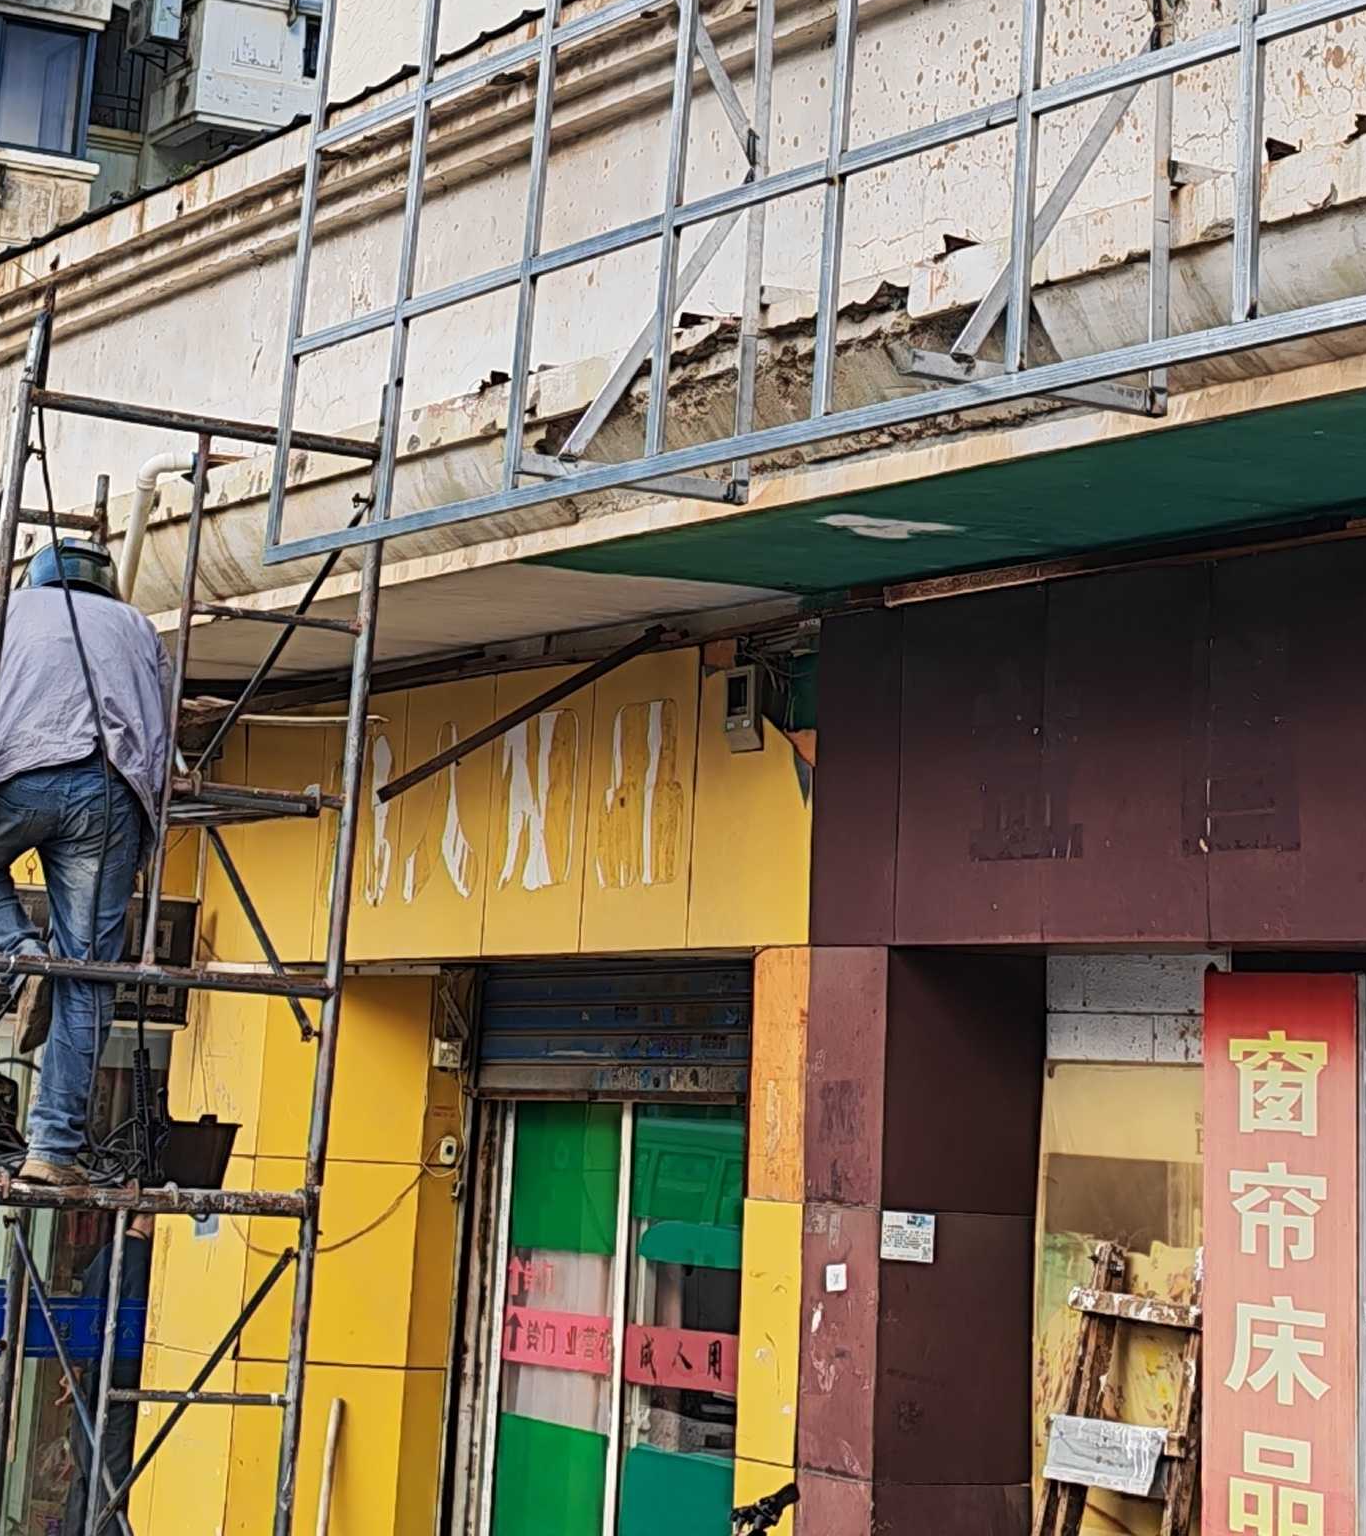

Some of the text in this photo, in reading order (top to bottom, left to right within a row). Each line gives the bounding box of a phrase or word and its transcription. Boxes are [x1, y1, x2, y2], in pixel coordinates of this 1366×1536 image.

[638, 1333, 725, 1382] 成人用
[1223, 1030, 1332, 1536] 窗帘床品
